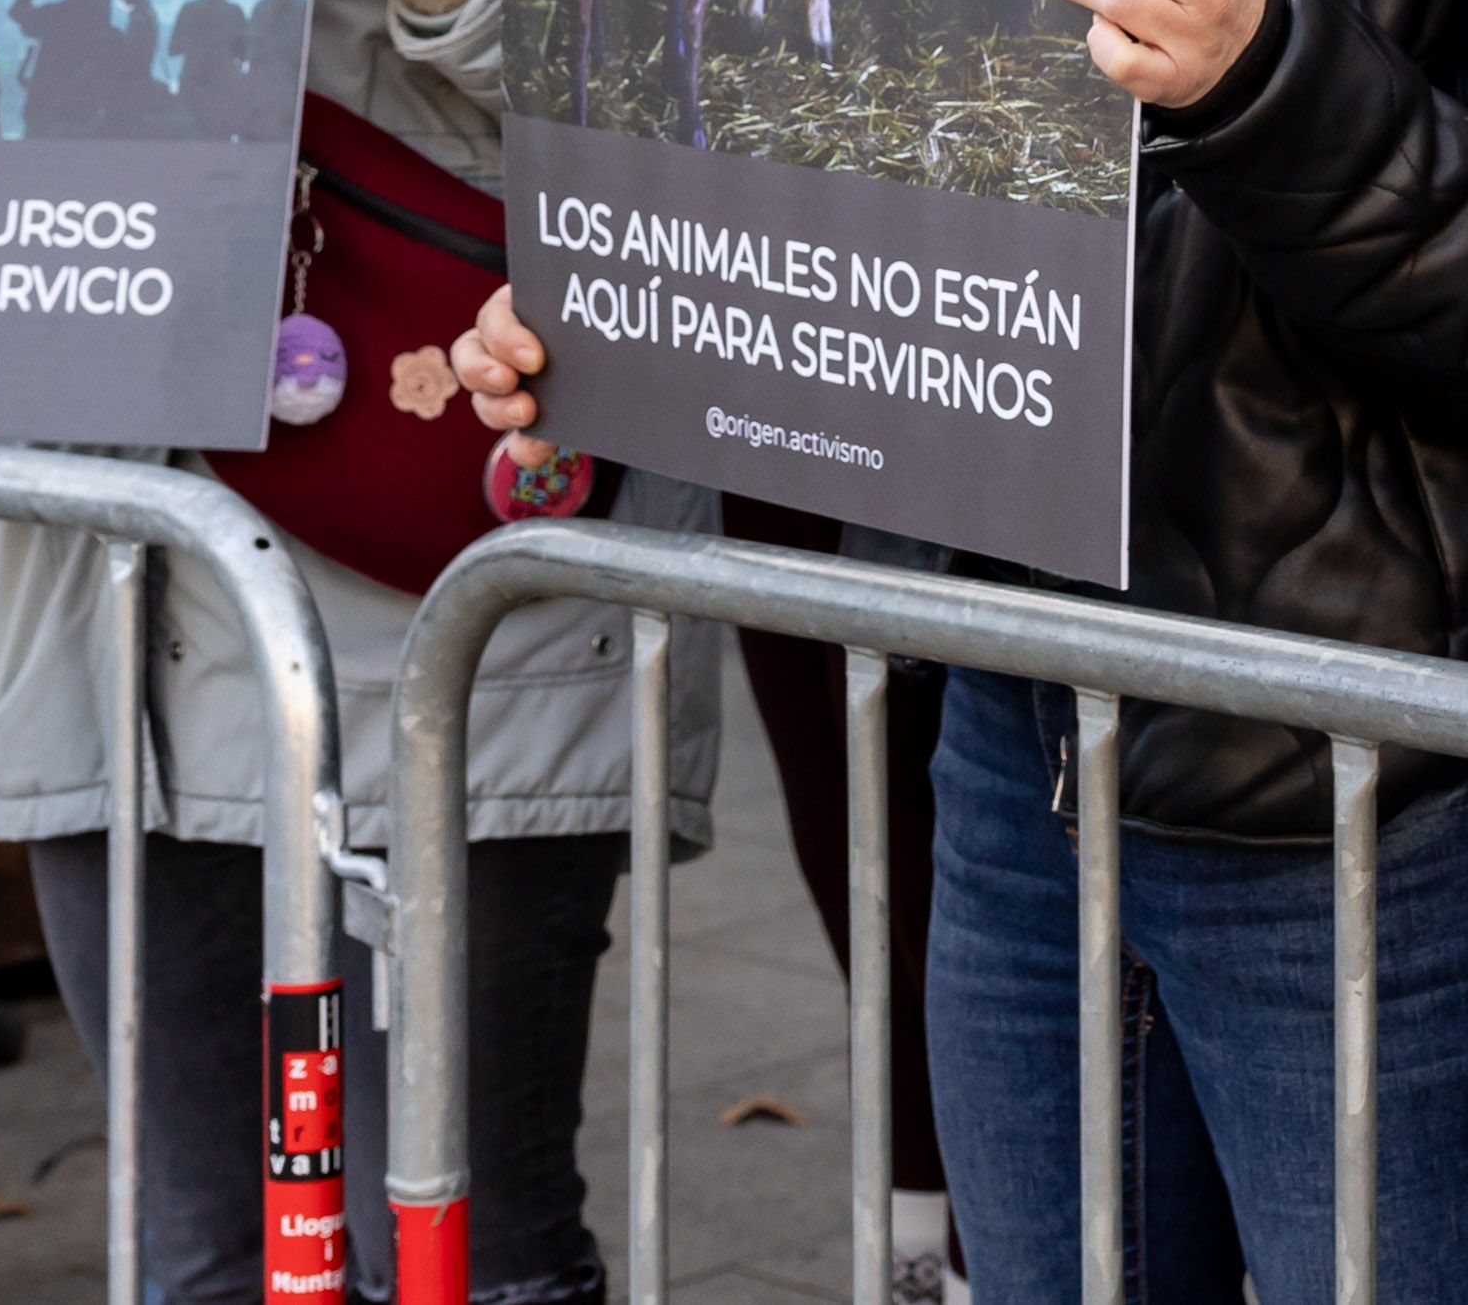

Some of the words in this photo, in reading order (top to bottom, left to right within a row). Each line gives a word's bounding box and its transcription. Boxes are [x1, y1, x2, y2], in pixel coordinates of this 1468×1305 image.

[538, 191, 614, 257] LOS
[620, 208, 837, 303] ANIMALES
[851, 252, 922, 318] NO
[935, 268, 1082, 351] ESTÁN
[561, 272, 663, 344] AQUÍ
[672, 294, 784, 372] PARA
[791, 321, 1054, 428] SERVIRNOS
[706, 405, 884, 471] @origen.activismo
